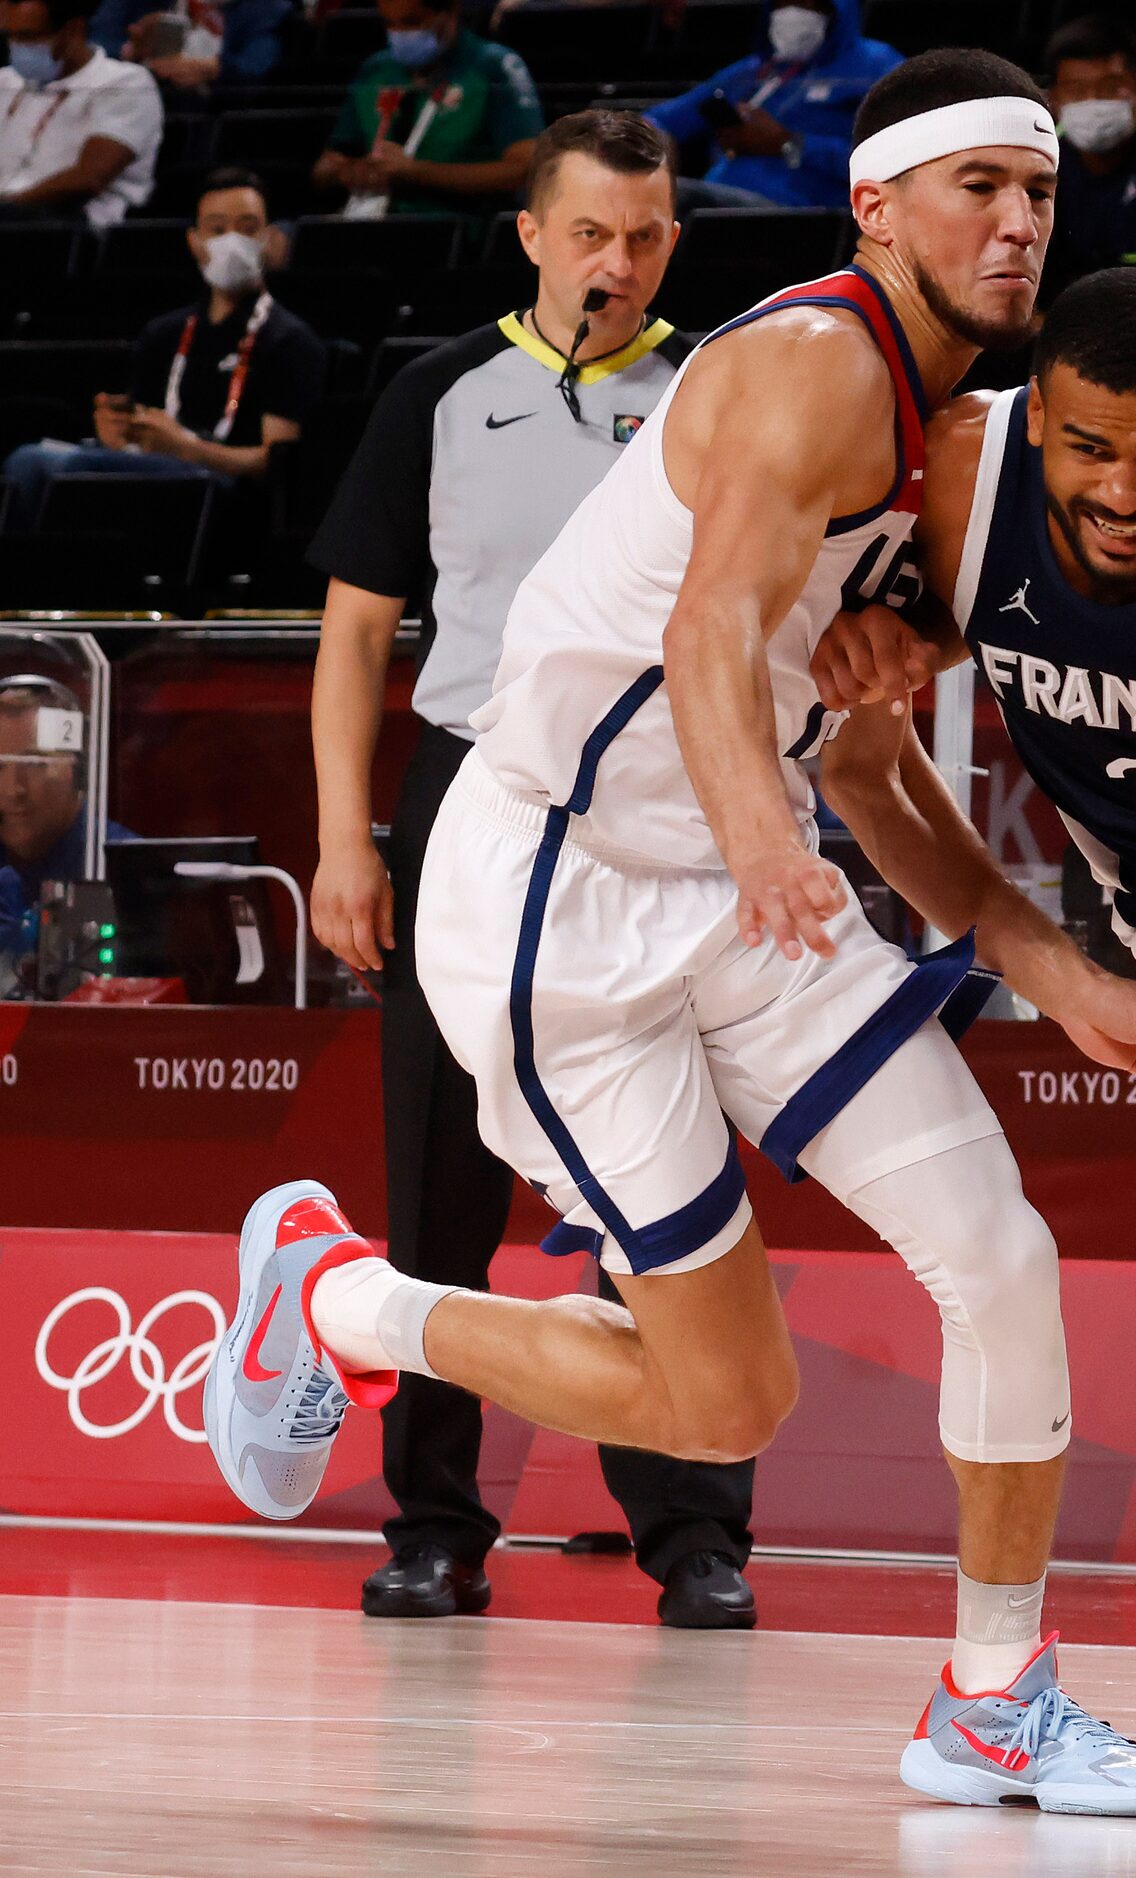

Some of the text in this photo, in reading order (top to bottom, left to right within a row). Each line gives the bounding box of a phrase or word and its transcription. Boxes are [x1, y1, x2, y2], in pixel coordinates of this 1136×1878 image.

[62, 719, 73, 742] 2
[134, 1057, 299, 1090] TOKYO 2020
[1018, 1070, 1120, 1105] TOKYO
